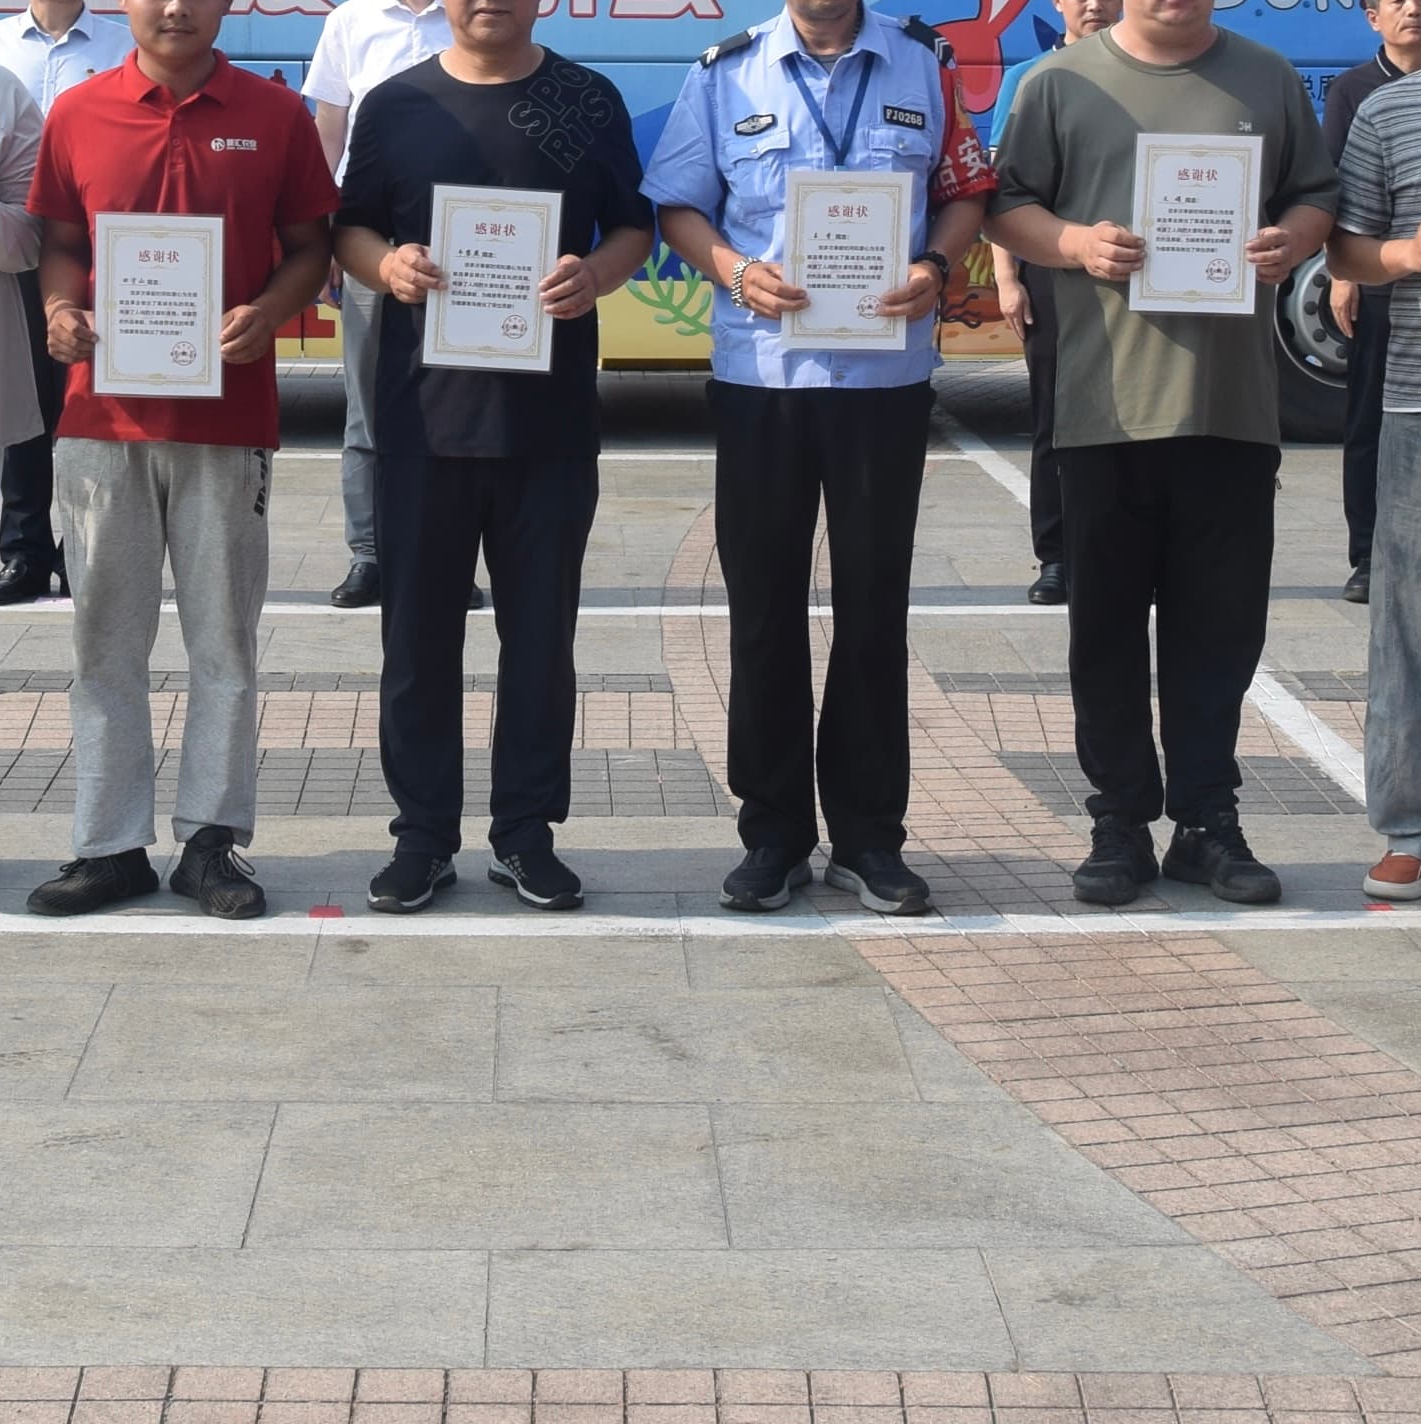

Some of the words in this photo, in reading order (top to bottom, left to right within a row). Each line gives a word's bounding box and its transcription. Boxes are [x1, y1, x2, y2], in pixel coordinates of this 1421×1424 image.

[1178, 168, 1218, 181] 感谢状
[828, 205, 869, 218] 感谢状
[474, 222, 517, 237] 感谢状
[139, 249, 180, 264] 感谢状
